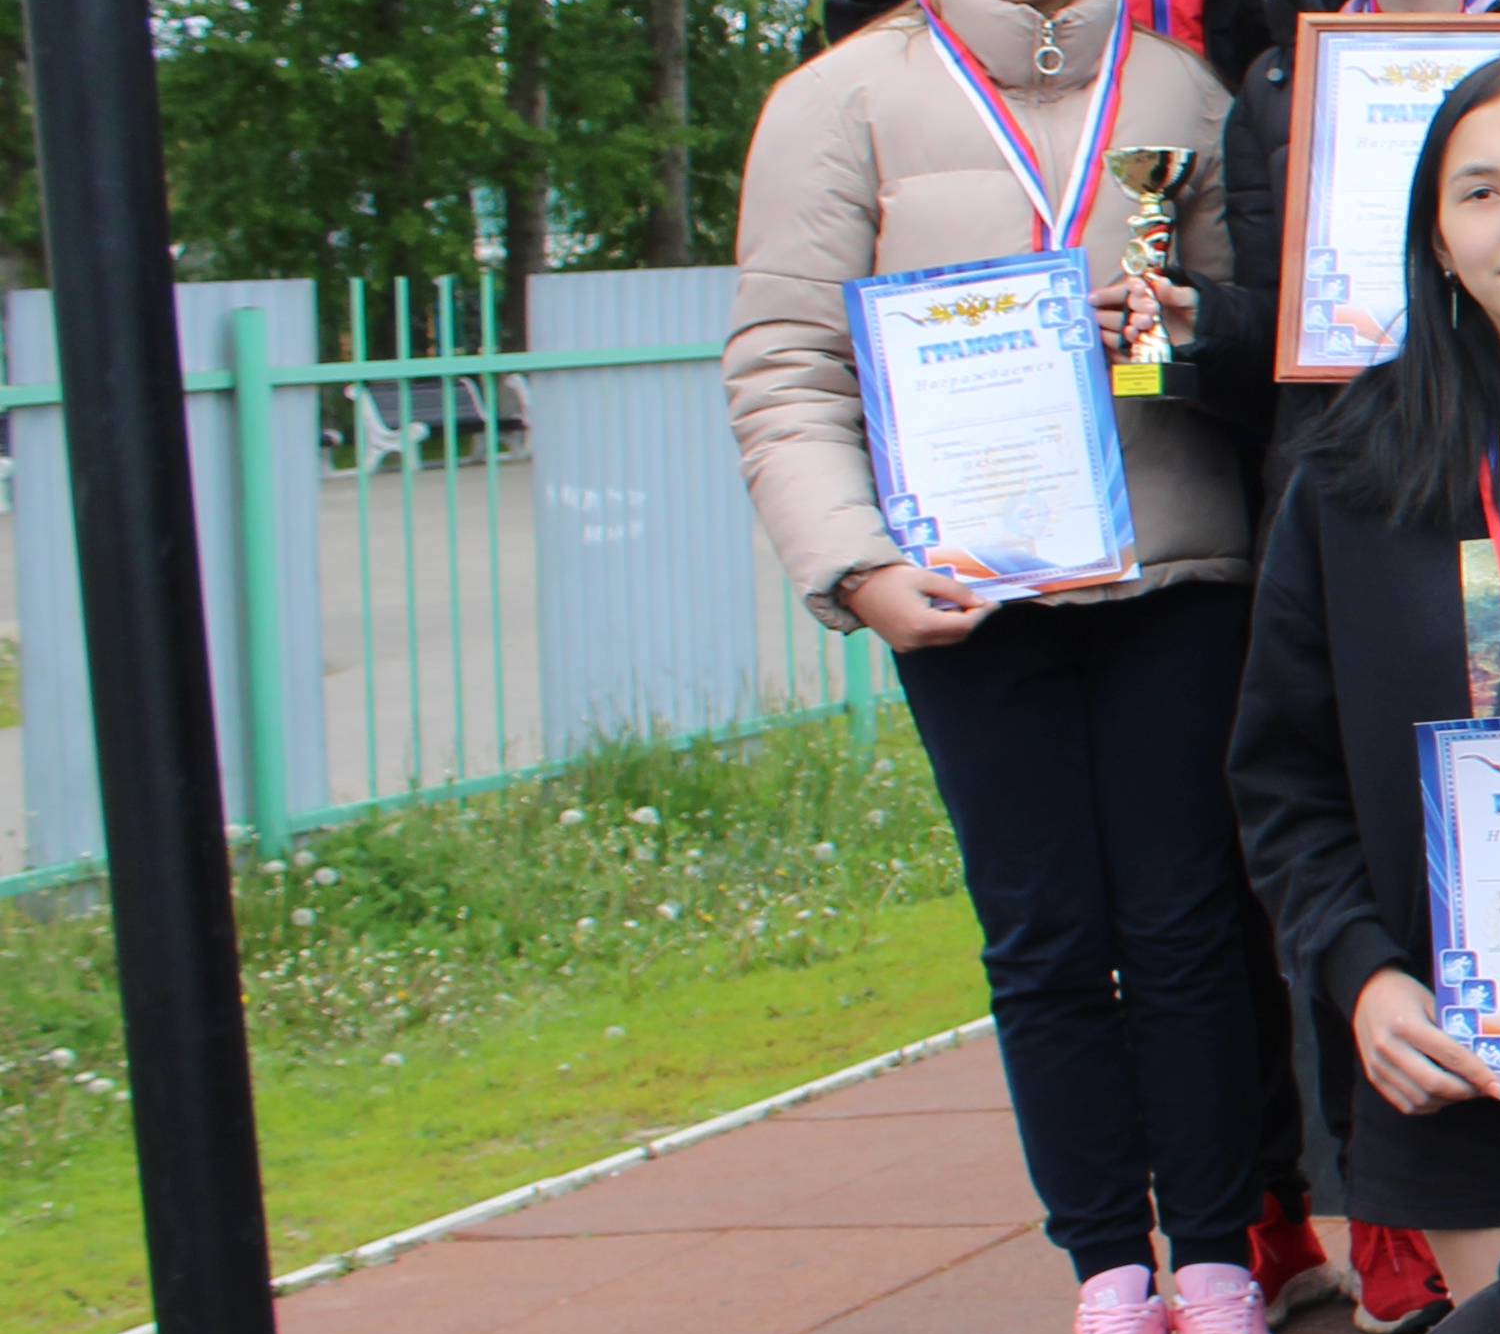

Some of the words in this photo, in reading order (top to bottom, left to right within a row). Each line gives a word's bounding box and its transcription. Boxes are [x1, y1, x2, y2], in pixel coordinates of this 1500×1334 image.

[1366, 103, 1435, 125] ГРАМ
[916, 328, 1040, 365] ГРАМОТА
[915, 361, 1055, 392] Награждается
